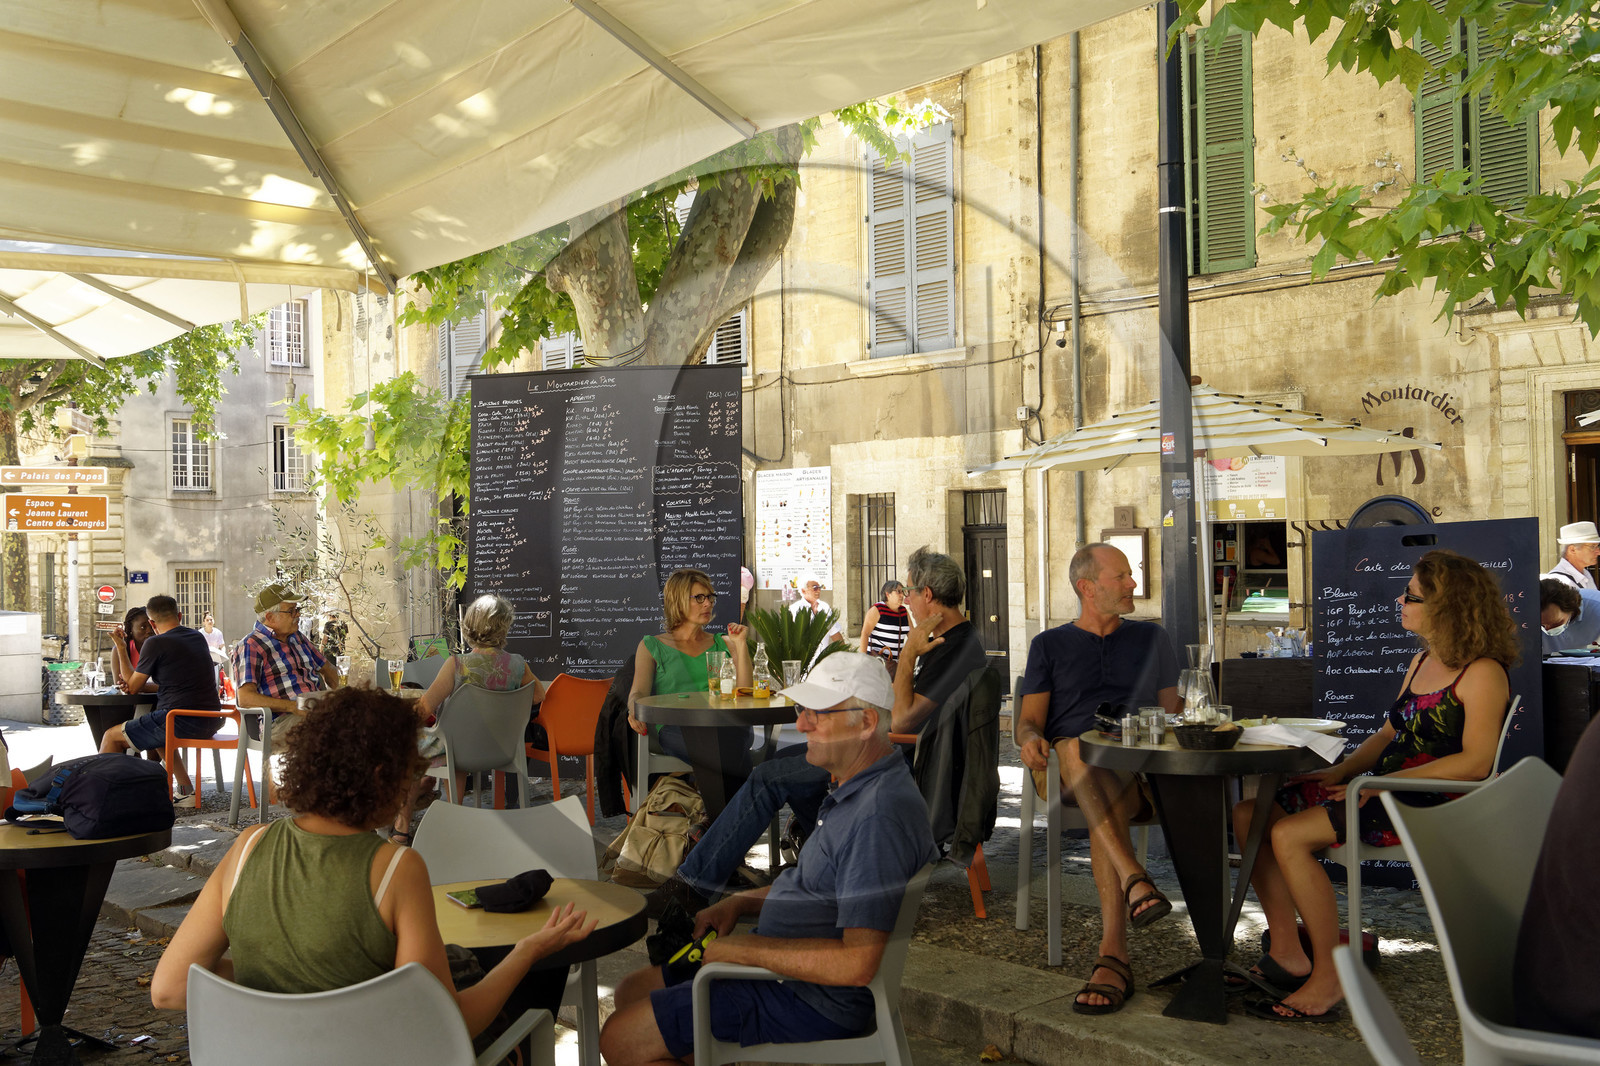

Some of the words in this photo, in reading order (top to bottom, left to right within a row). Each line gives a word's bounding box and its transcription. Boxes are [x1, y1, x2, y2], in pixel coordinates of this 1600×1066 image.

[1361, 384, 1464, 425] Moutardier
[1162, 440, 1175, 450] cgt
[75, 472, 102, 481] Papes
[26, 499, 54, 508] Espace
[1355, 558, 1384, 572] Carte
[1390, 560, 1410, 571] des
[1348, 604, 1366, 618] Pays
[1348, 617, 1365, 628] Pays
[1327, 631, 1343, 646] Pays
[1327, 650, 1342, 658] AOP
[1324, 690, 1354, 700] ROUGES
[1326, 711, 1342, 720] AOP
